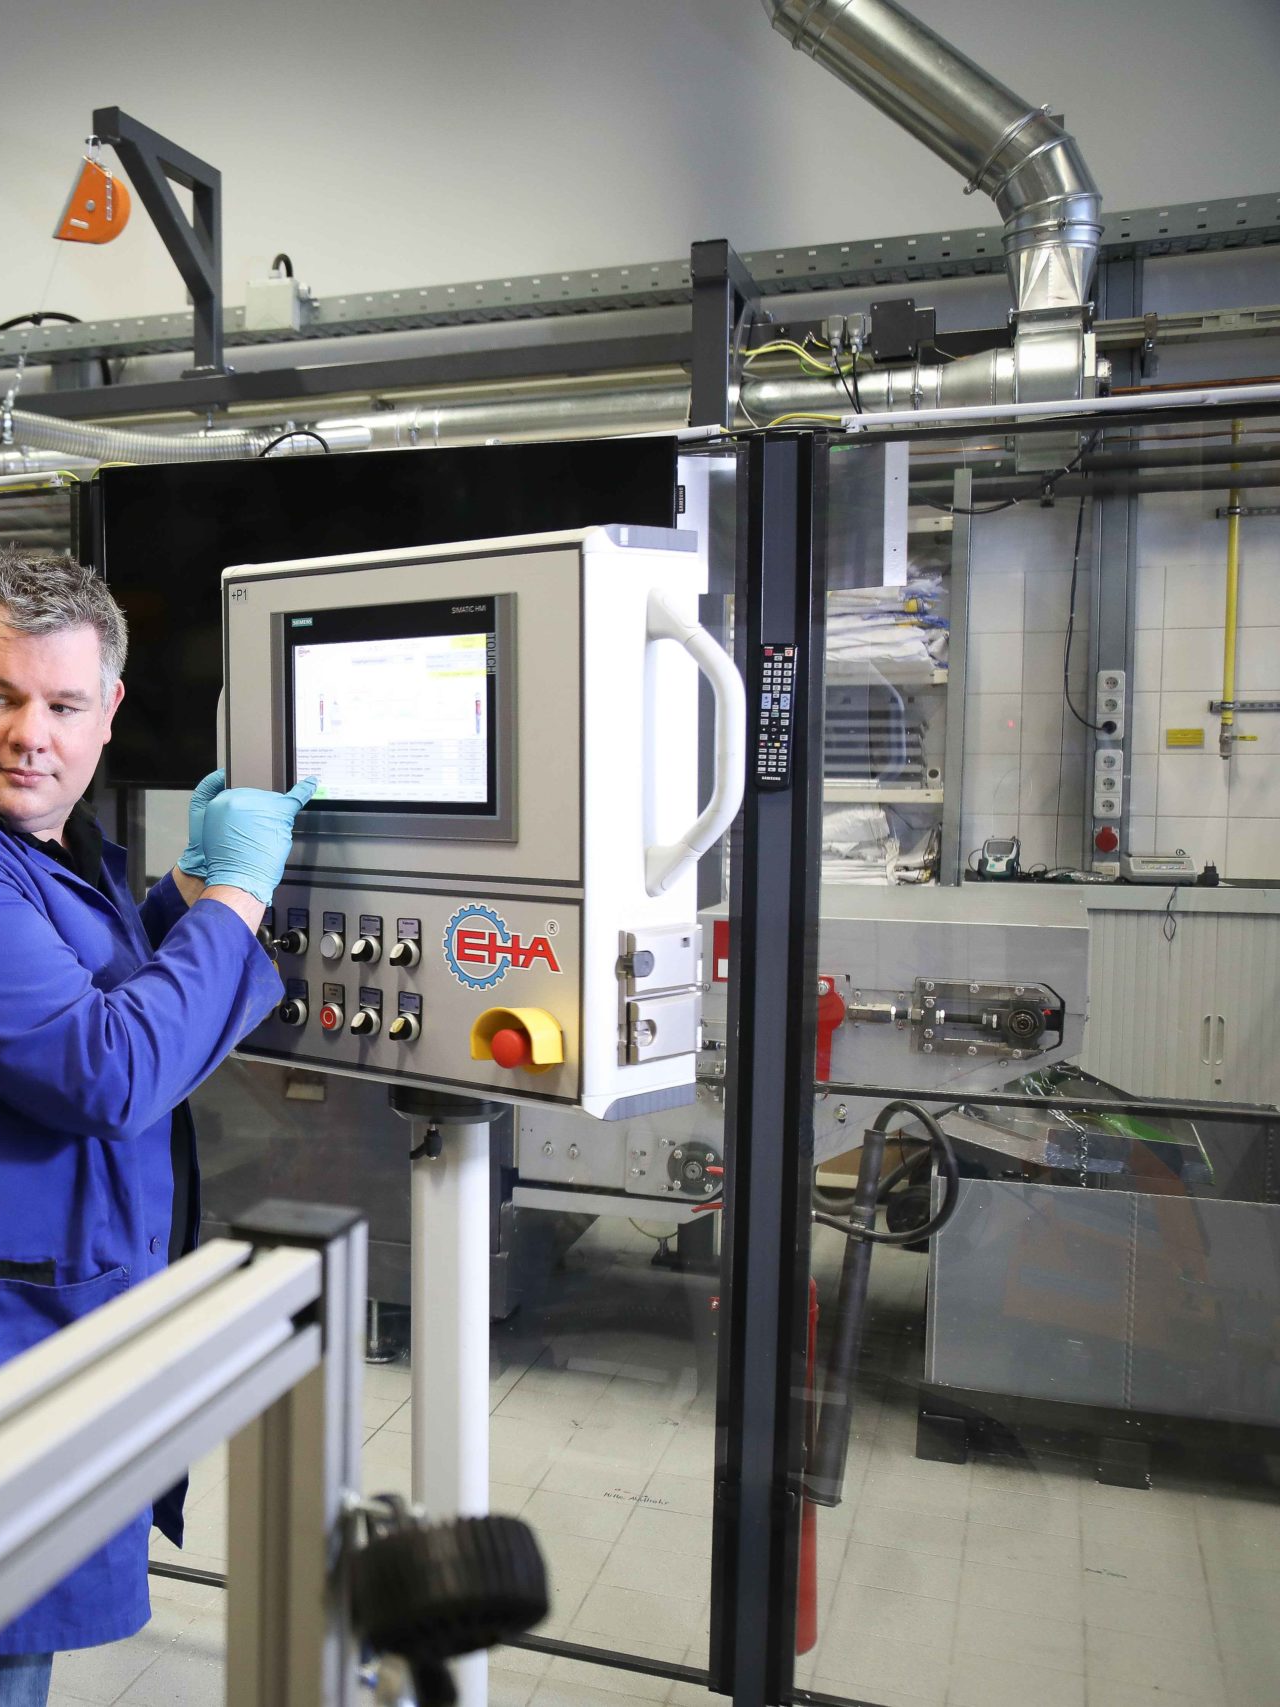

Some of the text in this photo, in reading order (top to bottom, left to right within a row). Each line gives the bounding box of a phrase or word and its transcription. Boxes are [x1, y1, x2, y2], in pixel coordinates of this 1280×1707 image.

[231, 589, 248, 601] +P1
[486, 634, 496, 673] TOUCH
[457, 929, 560, 972] EHA
